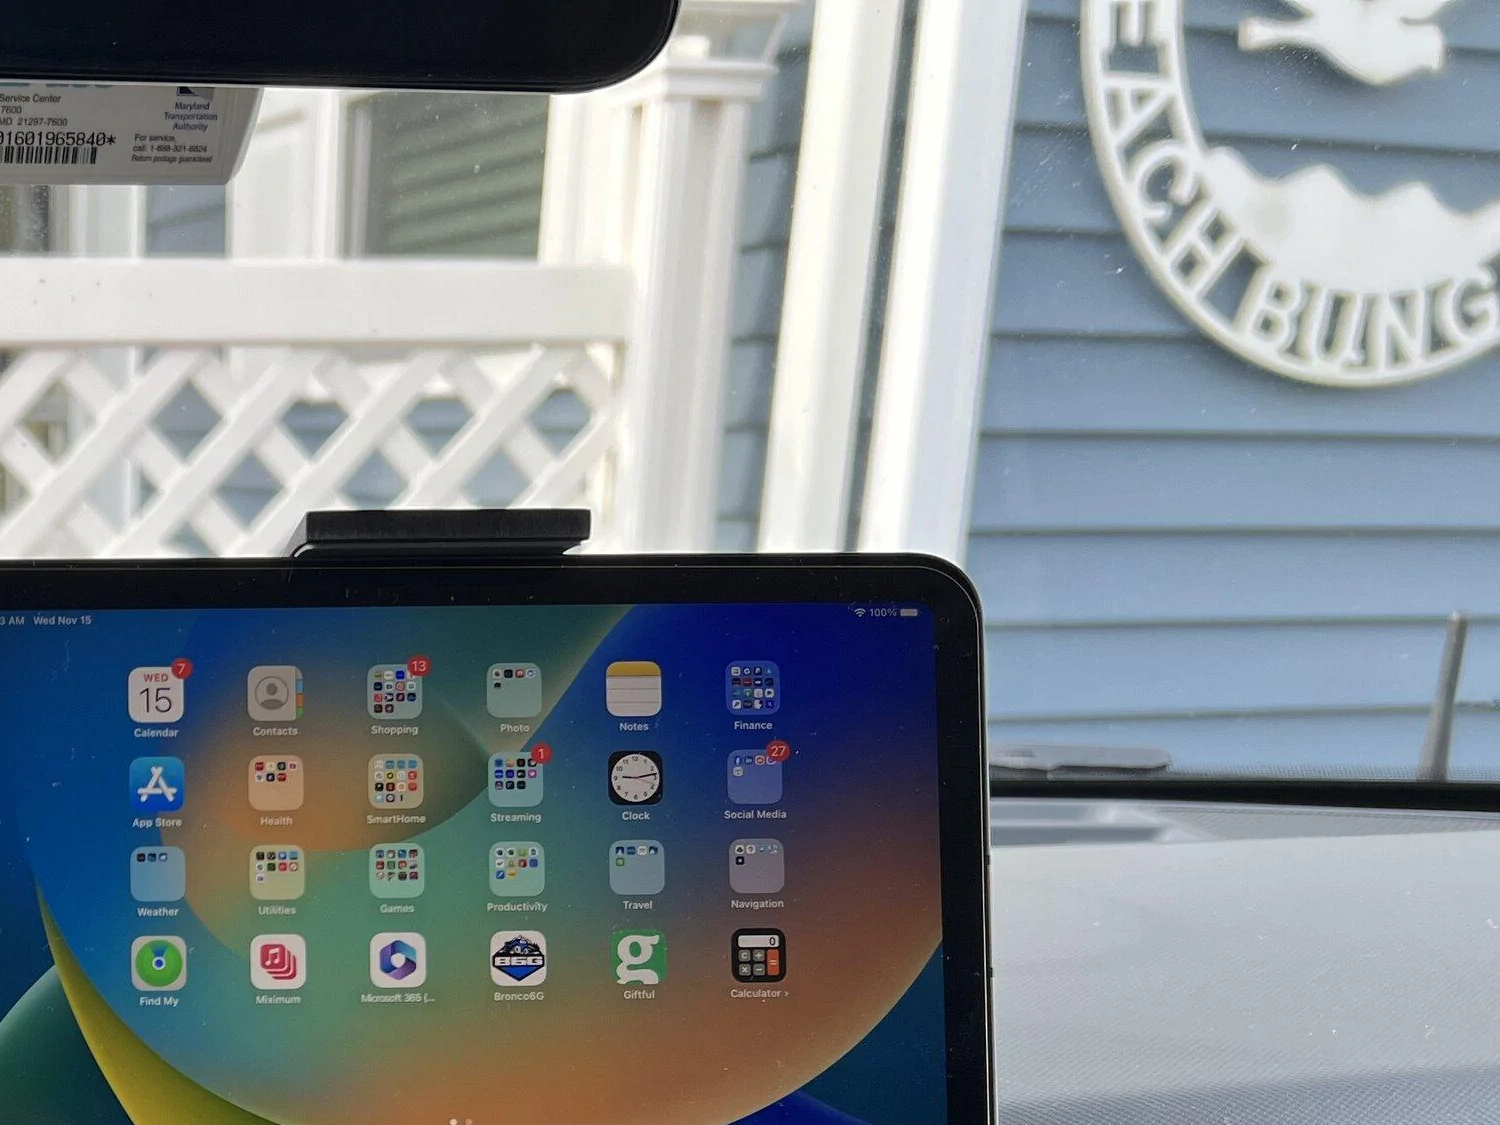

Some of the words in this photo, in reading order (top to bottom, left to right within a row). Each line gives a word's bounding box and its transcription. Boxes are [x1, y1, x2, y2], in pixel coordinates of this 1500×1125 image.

[32, 93, 62, 103] Center
[164, 111, 218, 122] Transportation
[173, 122, 209, 133] Authority
[134, 133, 147, 142] For
[869, 607, 898, 618] 100%
[8, 615, 25, 626] AM
[33, 615, 56, 626] Wed
[57, 615, 77, 626] Nov
[79, 615, 92, 626] 15
[177, 662, 186, 675] 7
[411, 659, 427, 673] 13
[142, 672, 169, 684] WED
[139, 687, 173, 715] 15
[252, 725, 298, 737] Contacts
[371, 724, 419, 736] Shopping
[499, 723, 530, 733] Photo
[619, 721, 650, 732] Notes
[733, 720, 773, 731] Finance
[133, 727, 179, 738] Calendar
[537, 746, 545, 759] 1
[770, 744, 787, 758] 27
[366, 813, 426, 825] SmartHome
[490, 811, 543, 824] Streaming
[621, 810, 651, 821] Clock
[724, 809, 754, 820] Social
[756, 809, 787, 820] Media
[132, 817, 152, 830] App
[155, 816, 182, 829] Store
[259, 815, 293, 827] Health
[380, 903, 415, 914] Games
[486, 902, 548, 914] Productivity
[622, 900, 653, 910] Travel
[730, 898, 784, 910] Navigation
[137, 905, 179, 917] Weather
[258, 905, 297, 916] Utilities
[361, 992, 402, 1004] Microsoft
[403, 993, 422, 1004] 365
[493, 991, 545, 1002] Bronco6G
[623, 989, 656, 1000] Giftful
[730, 988, 781, 999] Calculator
[139, 996, 161, 1007] Find
[163, 996, 179, 1008] My
[255, 994, 301, 1005] Miximum
